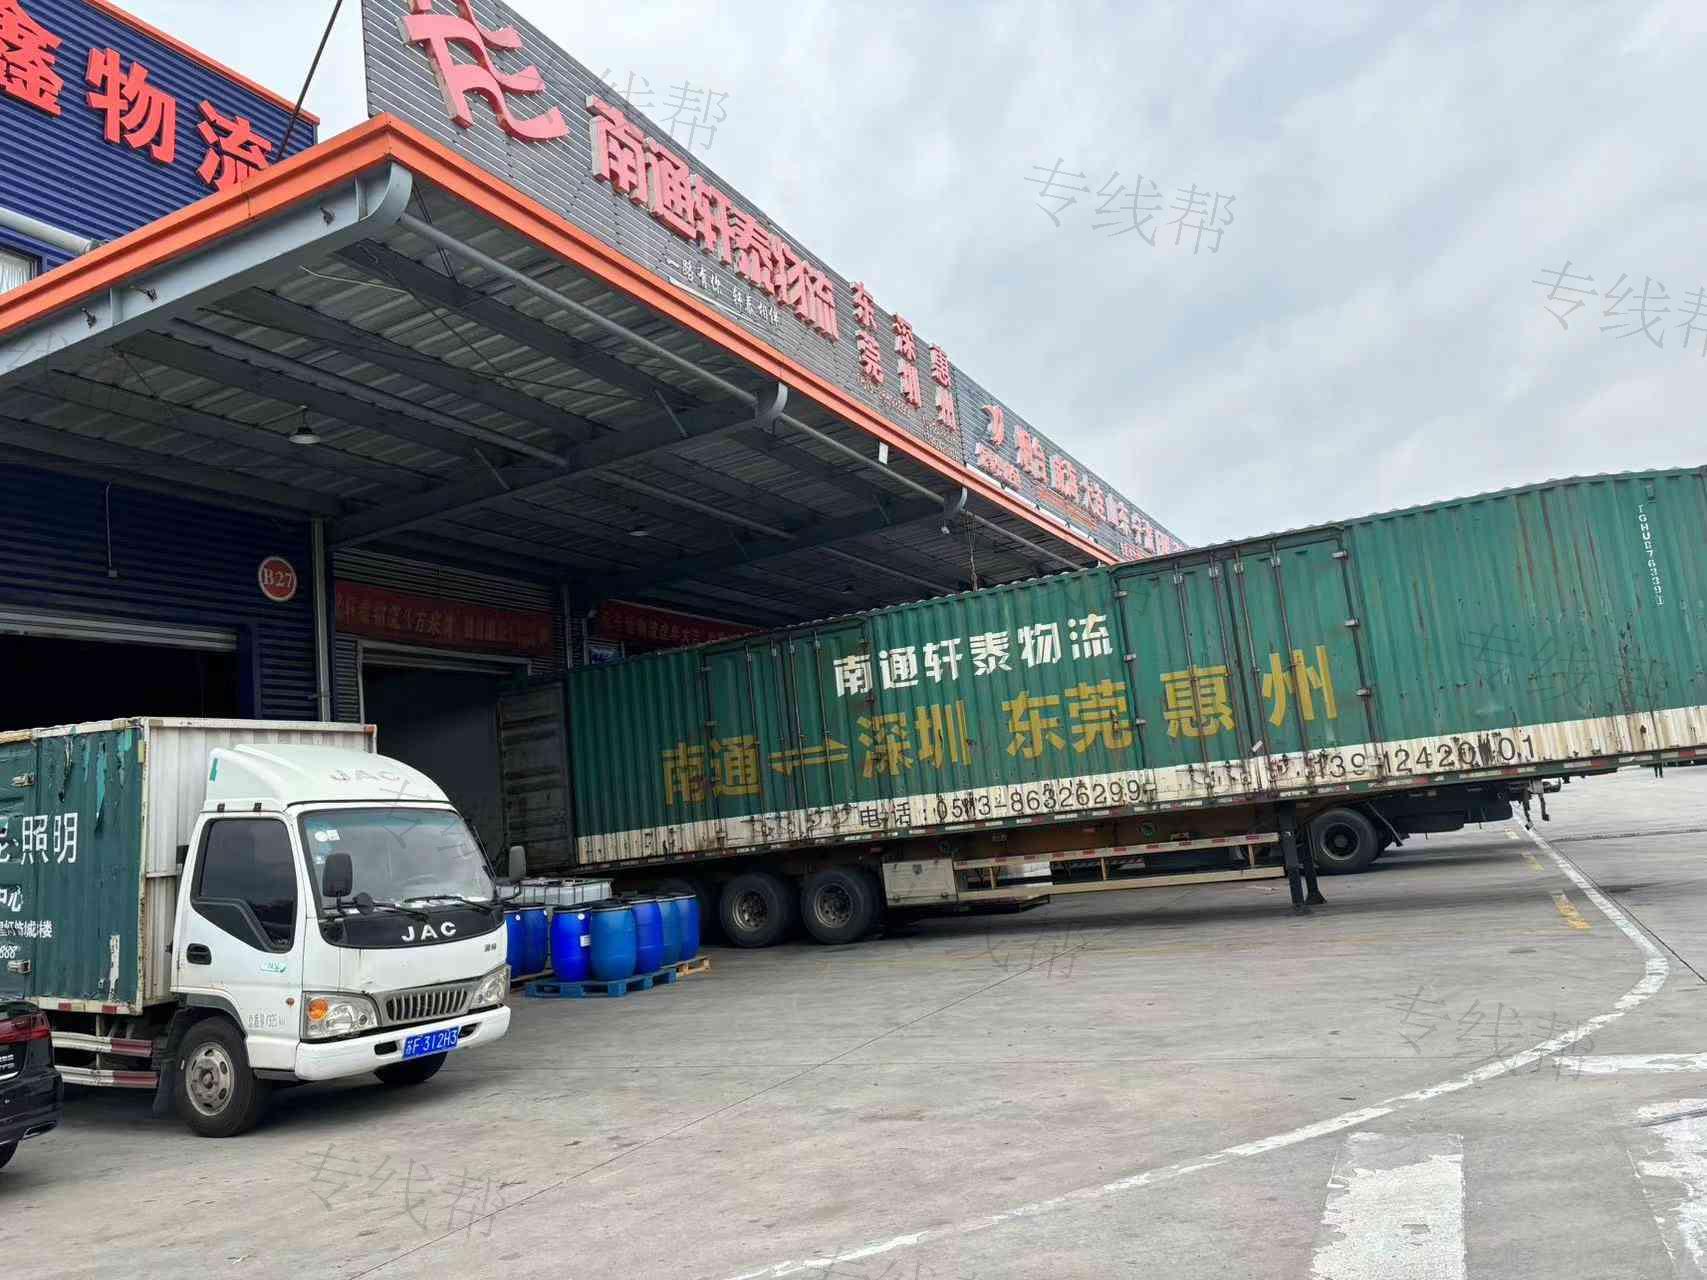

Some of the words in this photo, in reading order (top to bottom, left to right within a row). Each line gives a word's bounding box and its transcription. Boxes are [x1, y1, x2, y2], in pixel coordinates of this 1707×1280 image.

[586, 94, 840, 343] 南通轩泰物流
[849, 281, 885, 385] 东莞
[263, 567, 292, 588] B27
[832, 613, 1114, 697] 南通轩泰物流
[662, 735, 760, 806] 南通
[857, 700, 971, 779] 深圳
[1002, 678, 1132, 759] 东莞
[1159, 645, 1339, 738] 惠州
[401, 921, 457, 942] JAC
